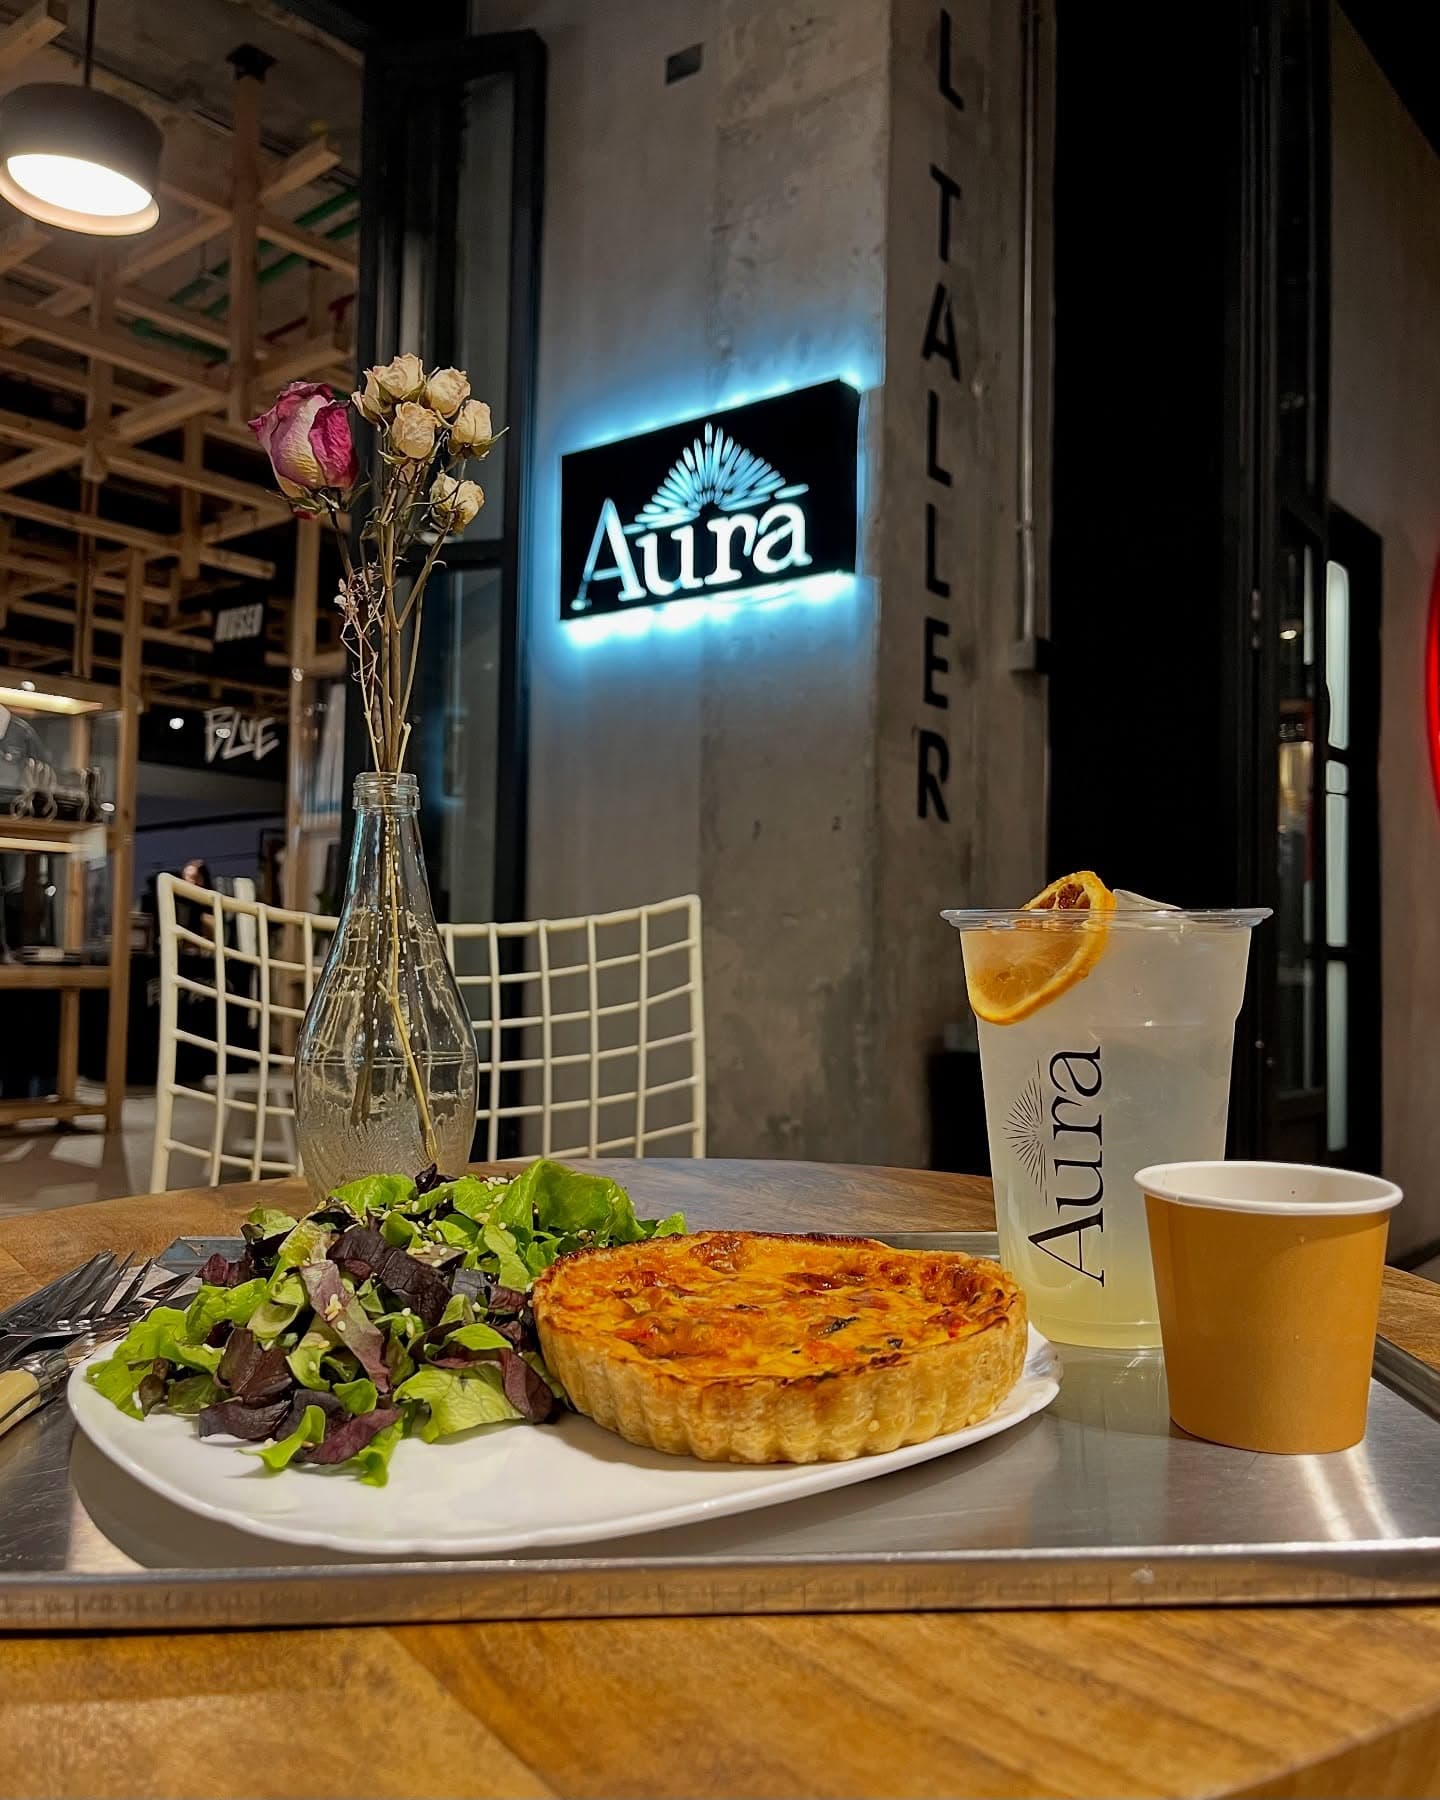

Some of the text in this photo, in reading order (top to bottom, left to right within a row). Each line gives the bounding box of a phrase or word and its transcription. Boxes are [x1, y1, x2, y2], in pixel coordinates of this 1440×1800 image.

[571, 496, 813, 611] Aura
[917, 163, 961, 822] TALLER
[203, 706, 281, 764] BLUE
[1028, 1046, 1104, 1287] Aura
